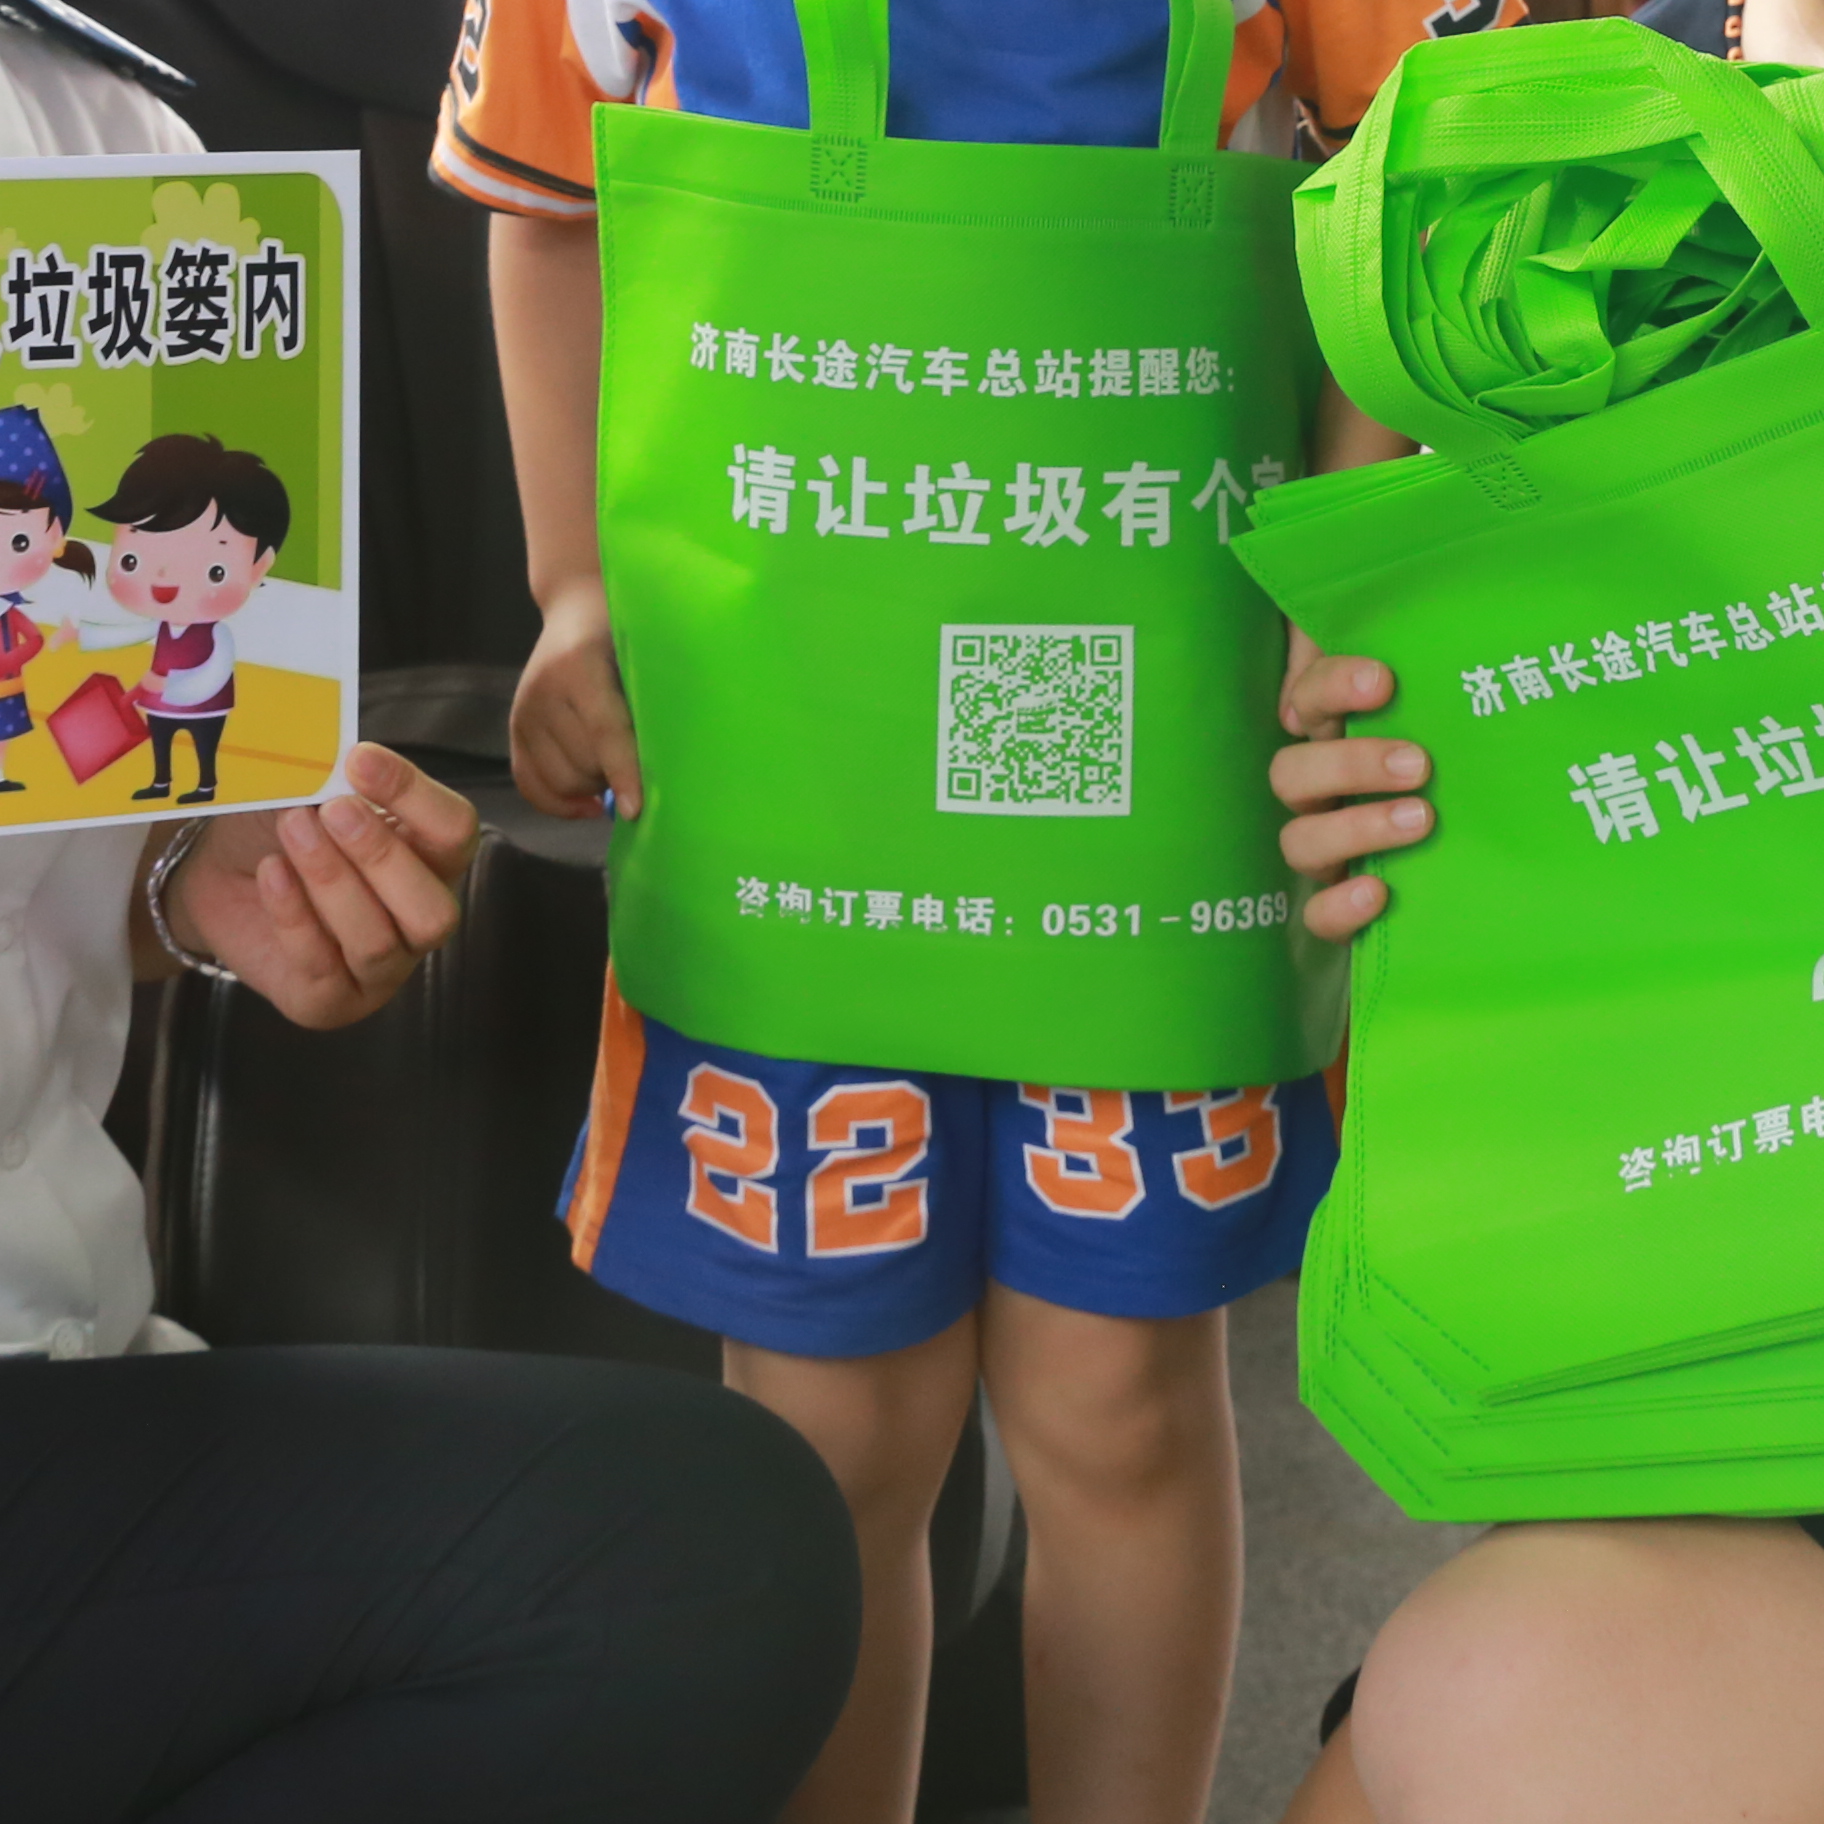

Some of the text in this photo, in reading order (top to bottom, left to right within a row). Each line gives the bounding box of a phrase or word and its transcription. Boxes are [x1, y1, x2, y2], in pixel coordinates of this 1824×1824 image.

[689, 322, 1236, 398] 济南长途汽车总站提醒您：
[677, 1061, 932, 1258] 22
[1018, 1081, 1283, 1221] 33
